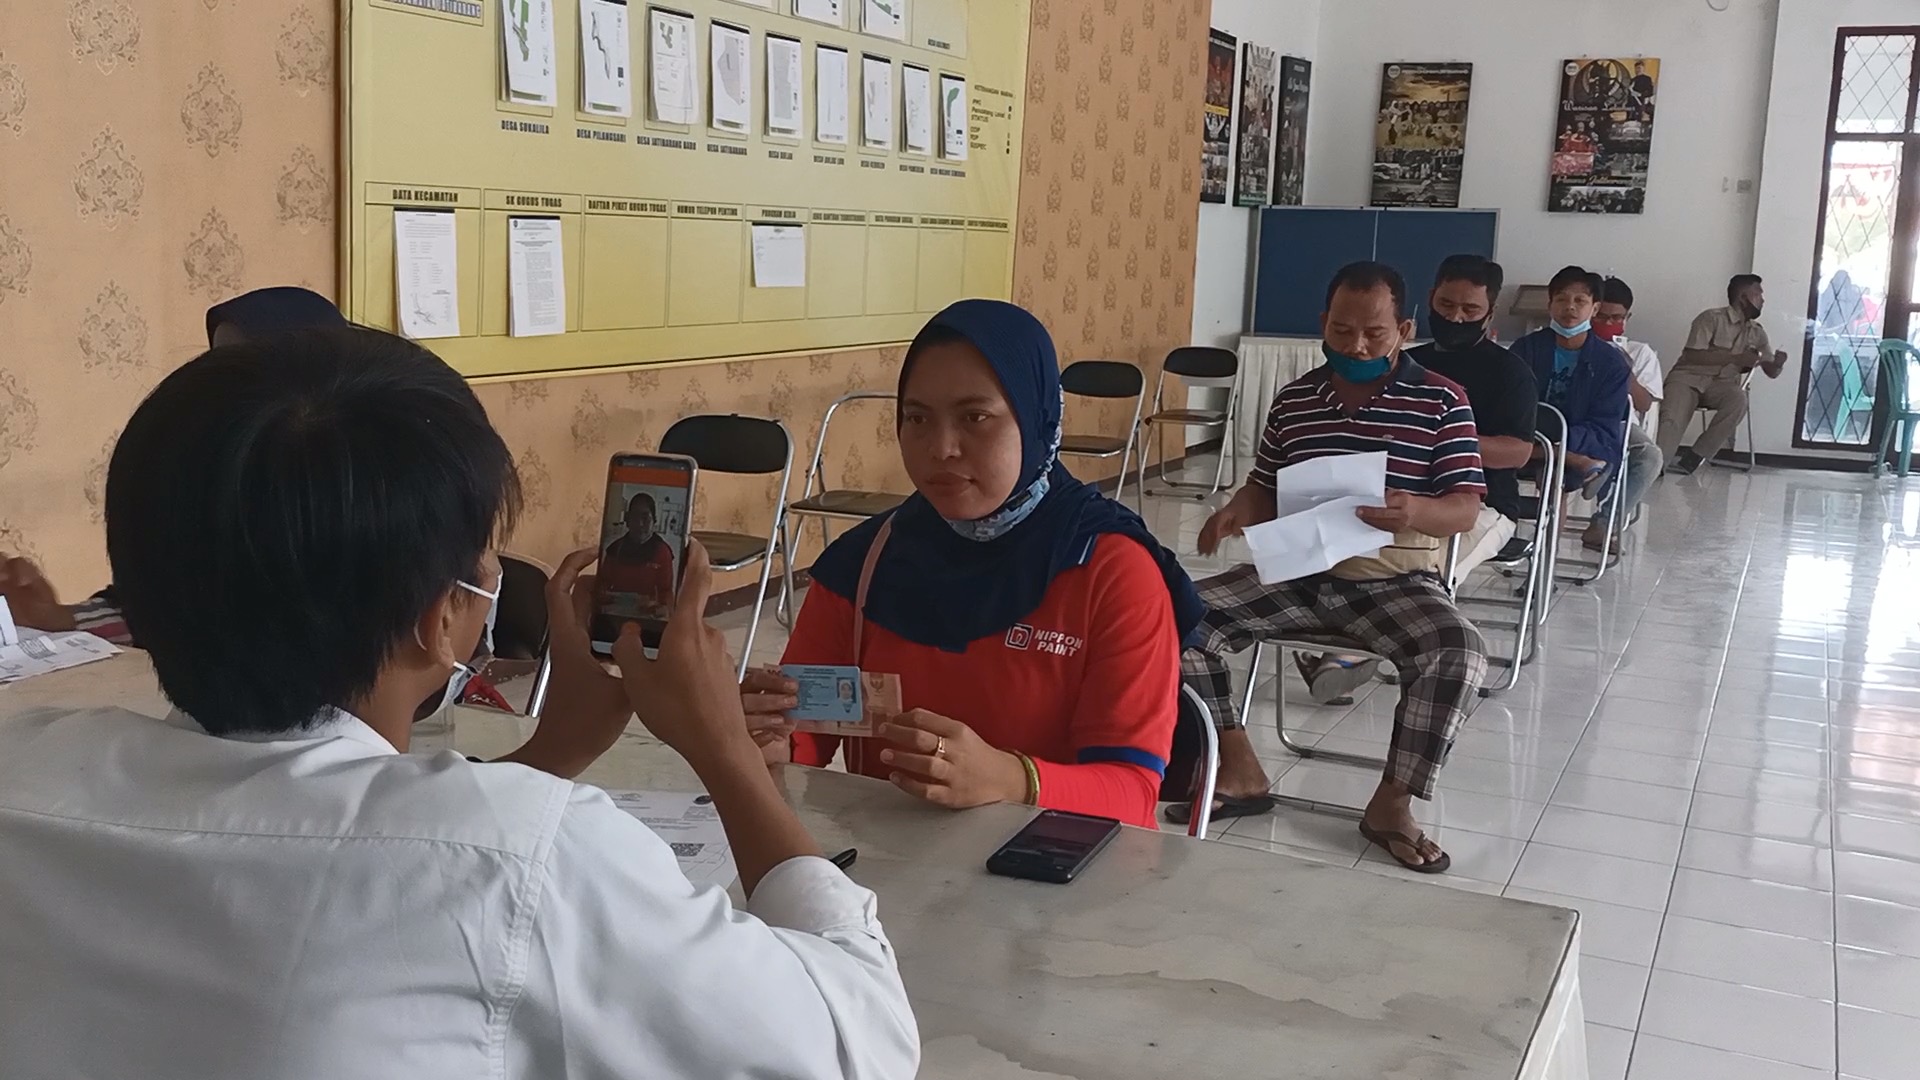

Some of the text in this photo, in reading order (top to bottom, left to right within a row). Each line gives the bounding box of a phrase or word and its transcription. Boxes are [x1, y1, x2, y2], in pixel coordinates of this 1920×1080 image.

[501, 120, 518, 131] DESA
[576, 128, 591, 139] DESA
[393, 189, 458, 202] DATA KECAMATAN
[506, 195, 562, 208] SK GUGUS TUGAS
[588, 200, 610, 211] DAFTAR
[611, 201, 628, 212] PIKET
[649, 203, 667, 213] TUGAS
[1034, 629, 1083, 649] NIPPON
[1037, 641, 1077, 657] PAINT
